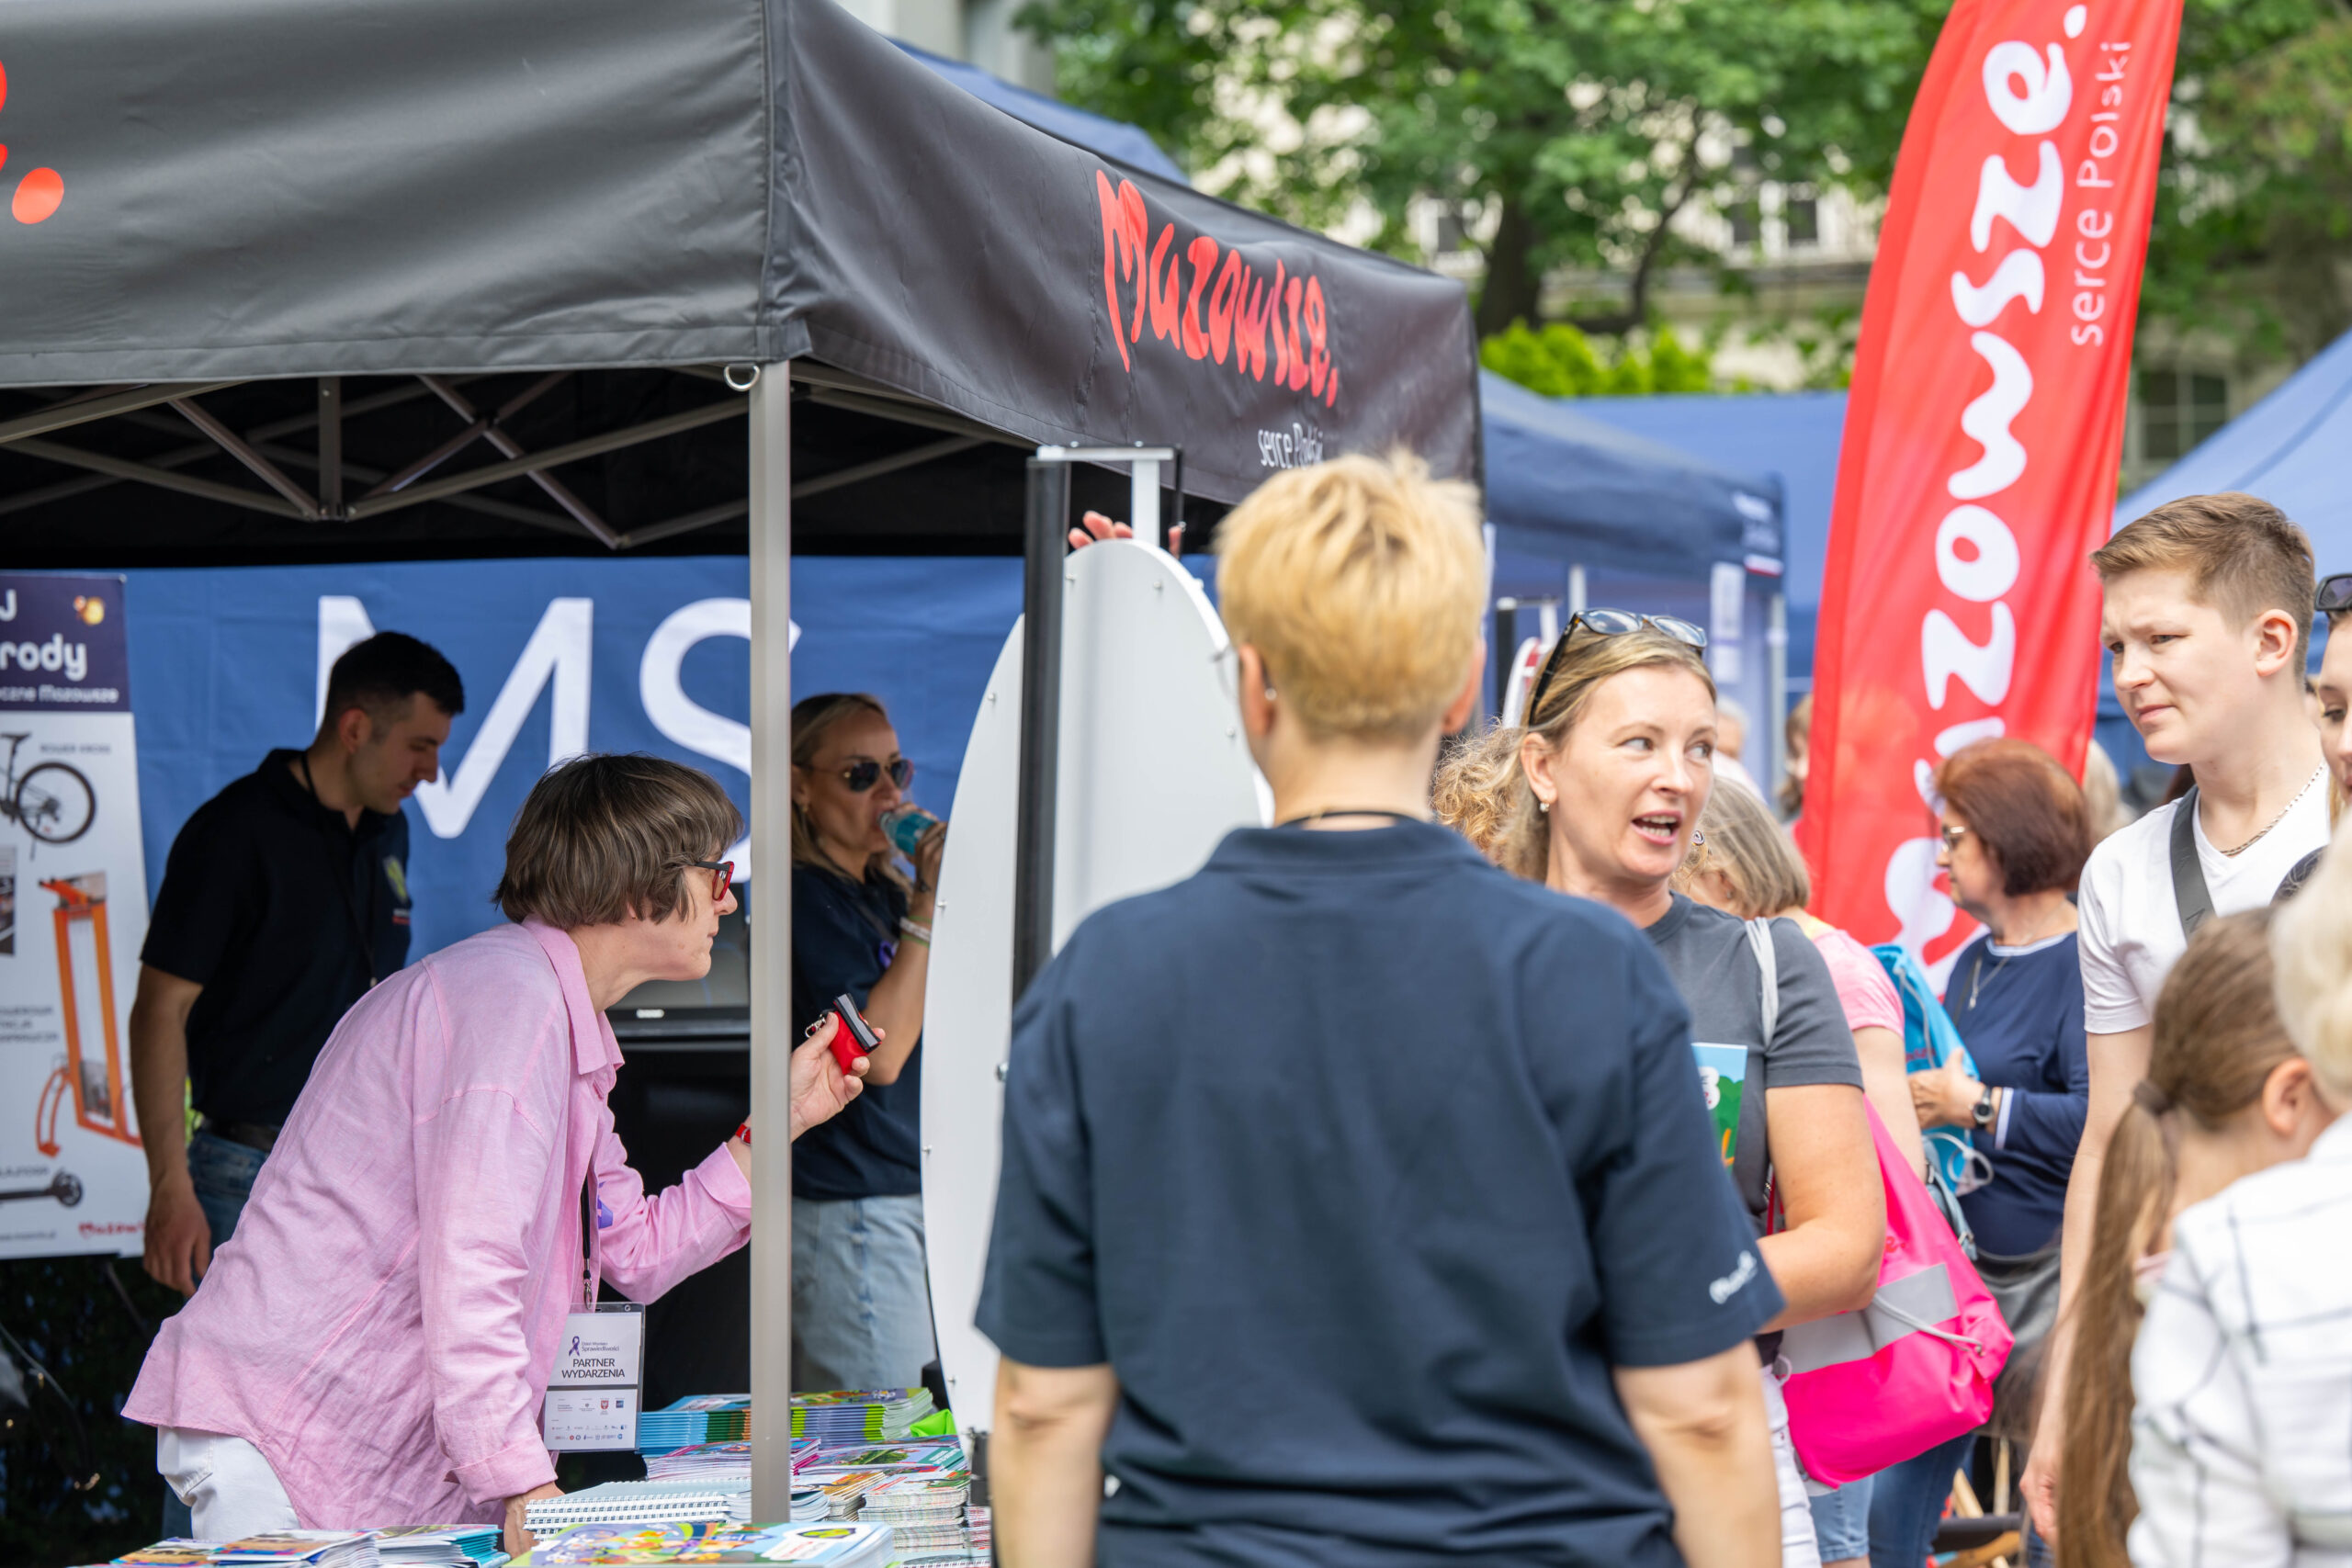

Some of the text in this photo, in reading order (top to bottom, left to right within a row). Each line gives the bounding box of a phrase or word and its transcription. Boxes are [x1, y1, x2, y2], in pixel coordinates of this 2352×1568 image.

[2070, 41, 2132, 347] serce Polski
[1258, 429, 1293, 469] serce
[0, 633, 87, 682] rody
[561, 1369, 626, 1379] WYDARZENIA
[572, 1358, 616, 1368] PARTNER
